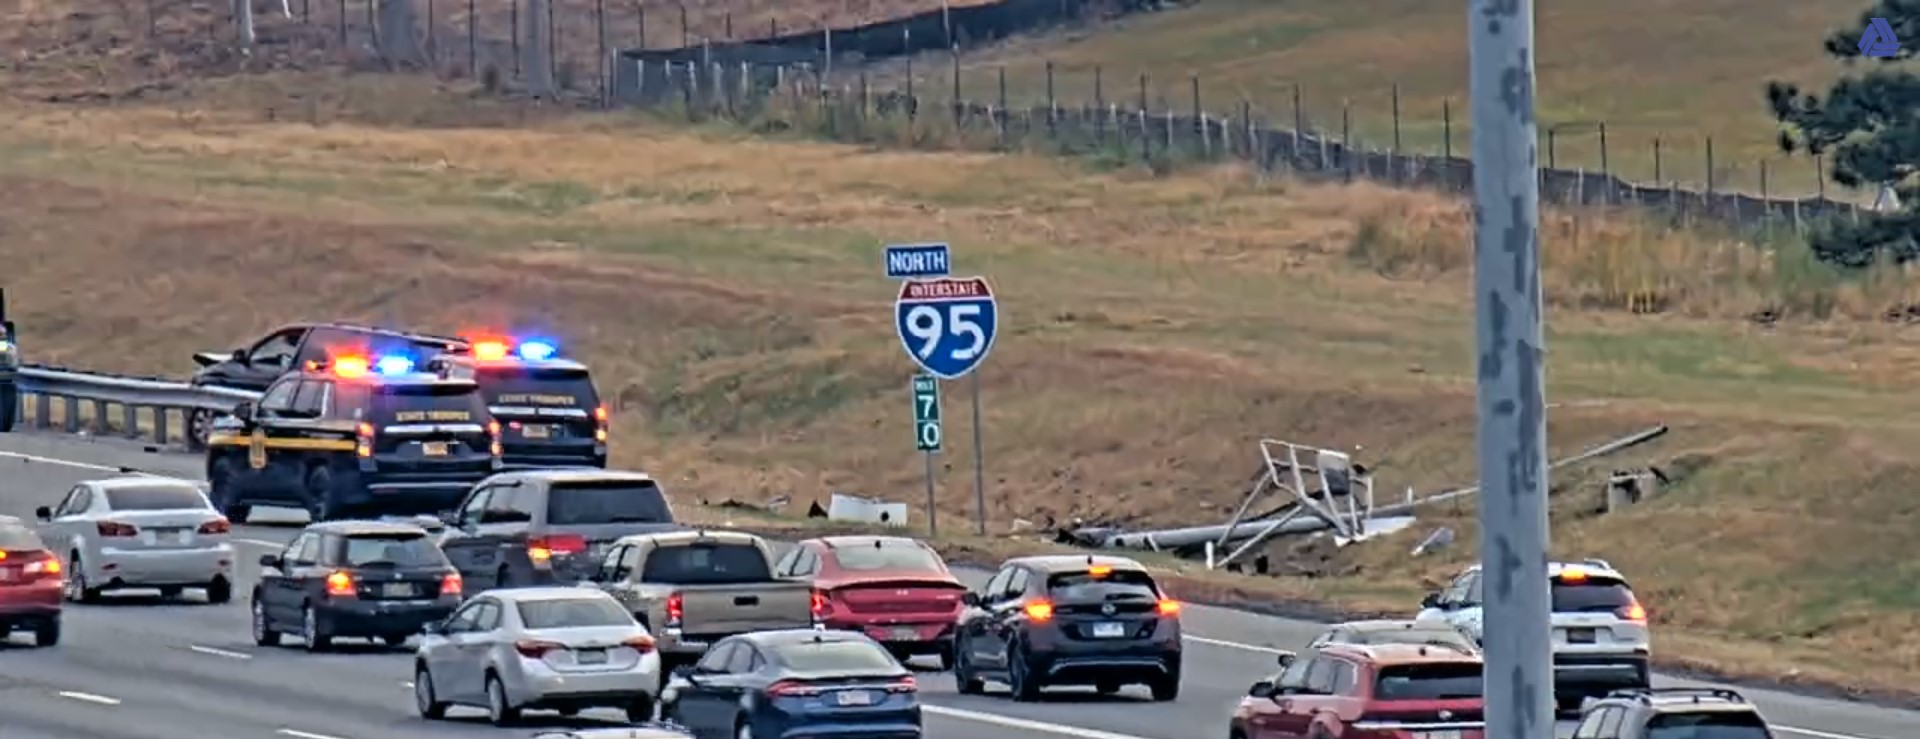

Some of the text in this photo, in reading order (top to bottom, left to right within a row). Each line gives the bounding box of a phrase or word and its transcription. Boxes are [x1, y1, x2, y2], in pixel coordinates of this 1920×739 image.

[889, 251, 946, 273] NORTH
[909, 282, 979, 297] INTERSTATE
[906, 305, 985, 360] 95
[917, 395, 935, 418] 7
